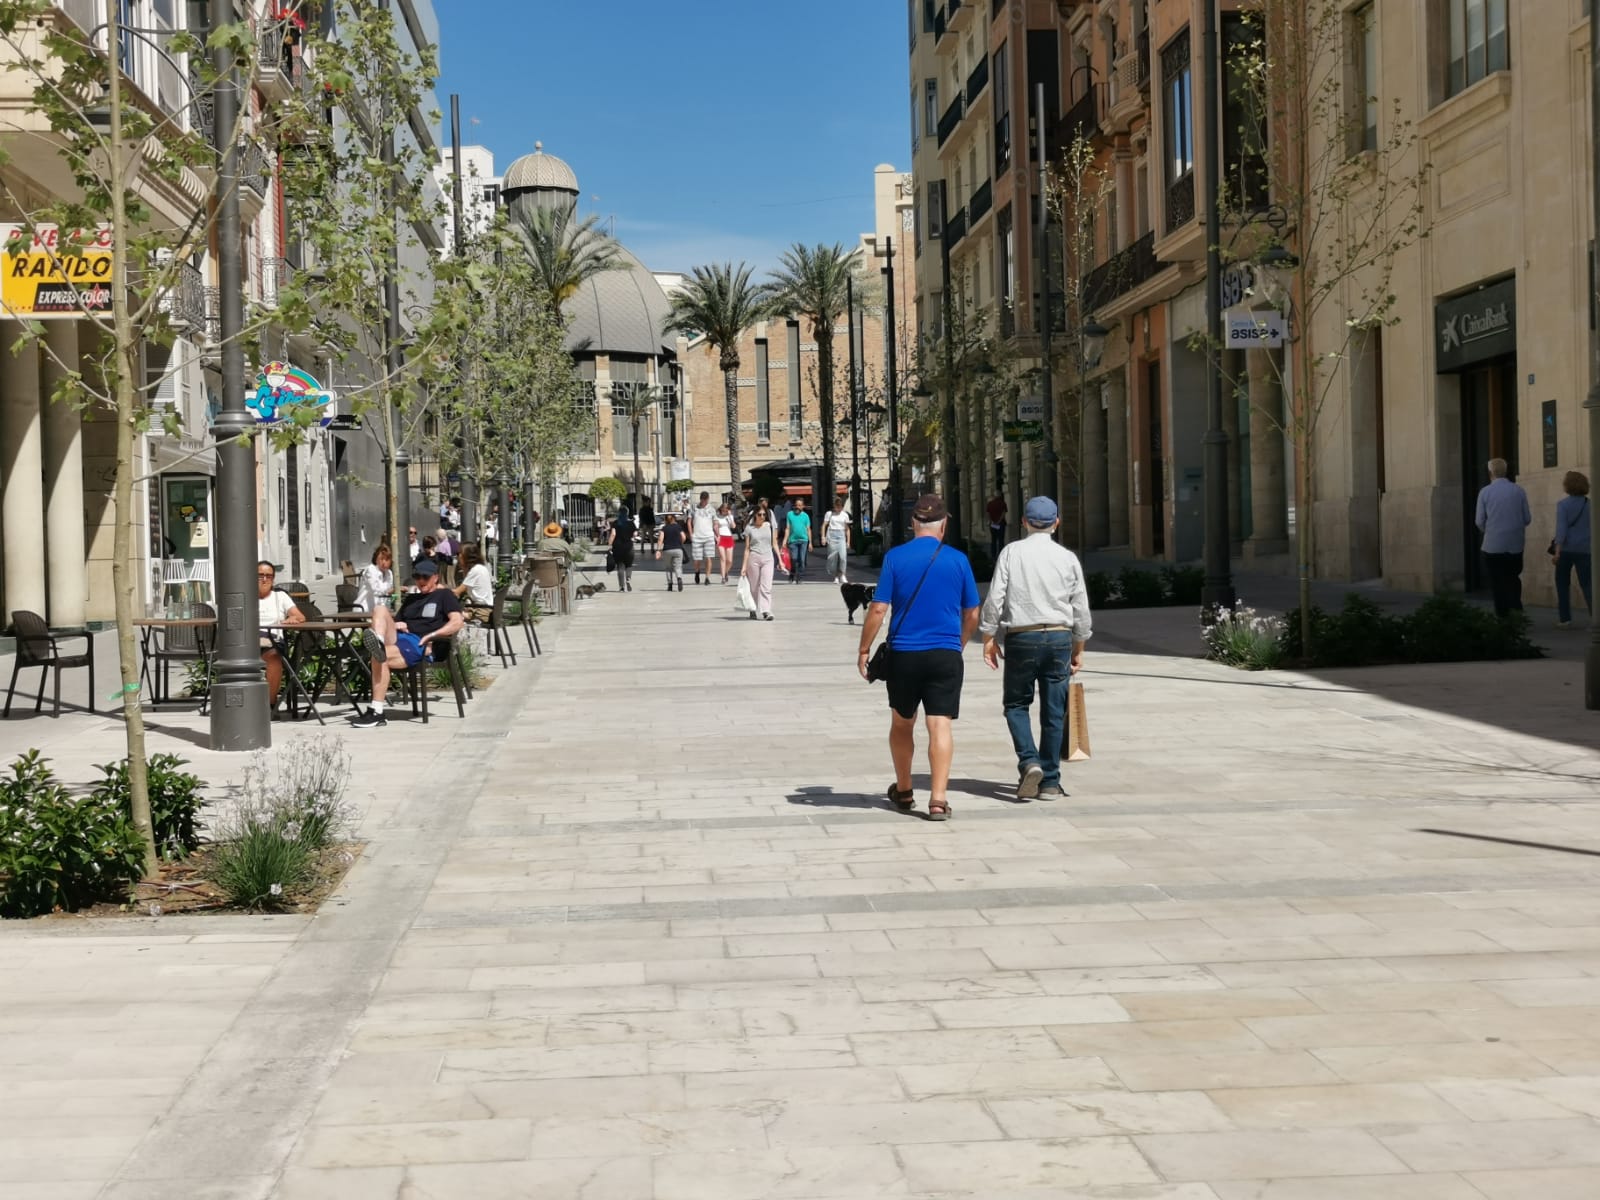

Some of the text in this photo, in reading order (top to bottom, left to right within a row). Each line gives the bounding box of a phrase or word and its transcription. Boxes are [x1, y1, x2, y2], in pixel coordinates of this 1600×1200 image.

[12, 256, 111, 278] RAPIDO
[38, 289, 111, 304] EXPRESS COLOR
[1461, 302, 1509, 337] CaixaBank
